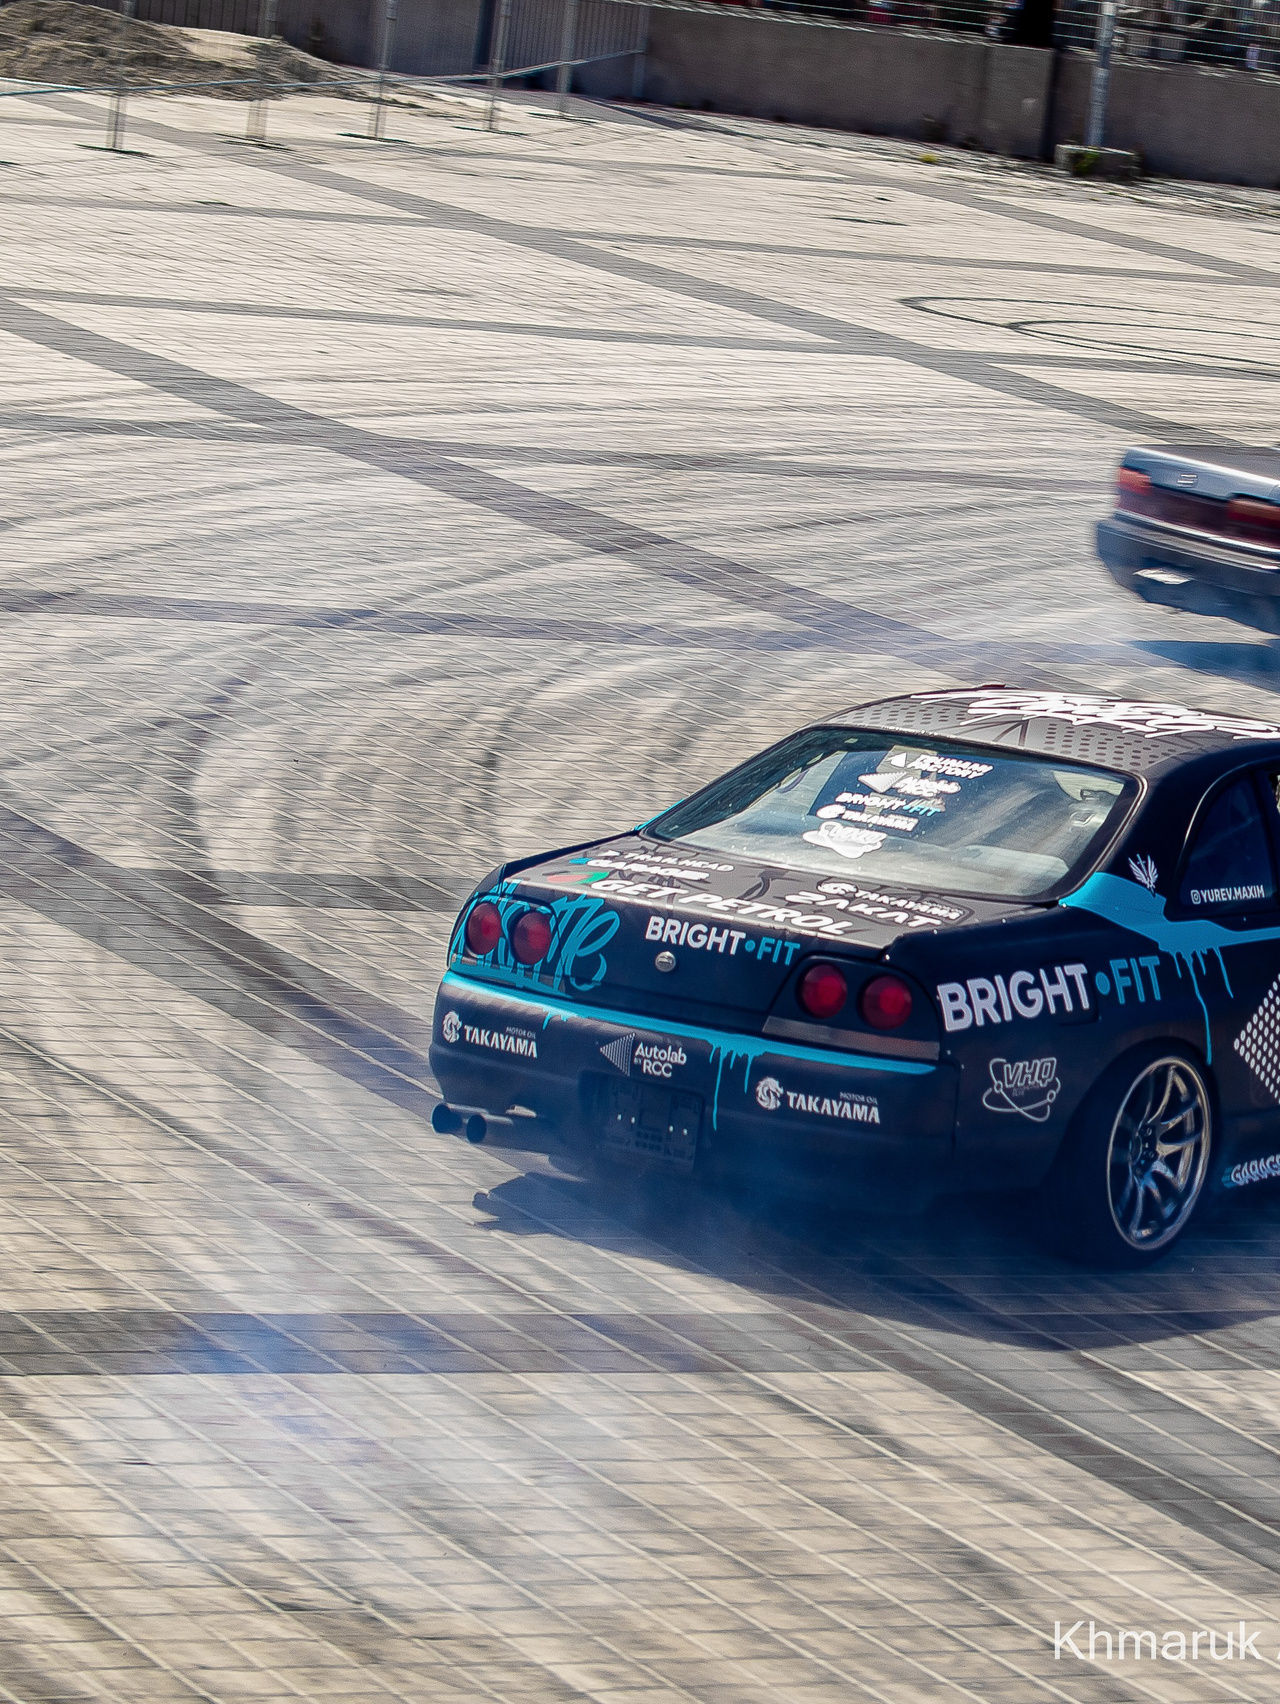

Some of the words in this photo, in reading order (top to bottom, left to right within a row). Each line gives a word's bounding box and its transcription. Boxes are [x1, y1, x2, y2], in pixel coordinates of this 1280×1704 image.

[622, 852, 735, 872] TRAILHEAD
[590, 879, 690, 899] GET
[678, 893, 853, 935] PETROL
[855, 890, 965, 920] TAKAYAMA
[464, 1025, 538, 1058] TAKAYAMA
[506, 1026, 527, 1037] MOTOR
[634, 1042, 687, 1065] Autolab
[633, 1057, 642, 1065] BY
[642, 1058, 672, 1078] RCC
[786, 1091, 880, 1124] TAKAYAMA
[840, 1091, 865, 1102] MOTOR
